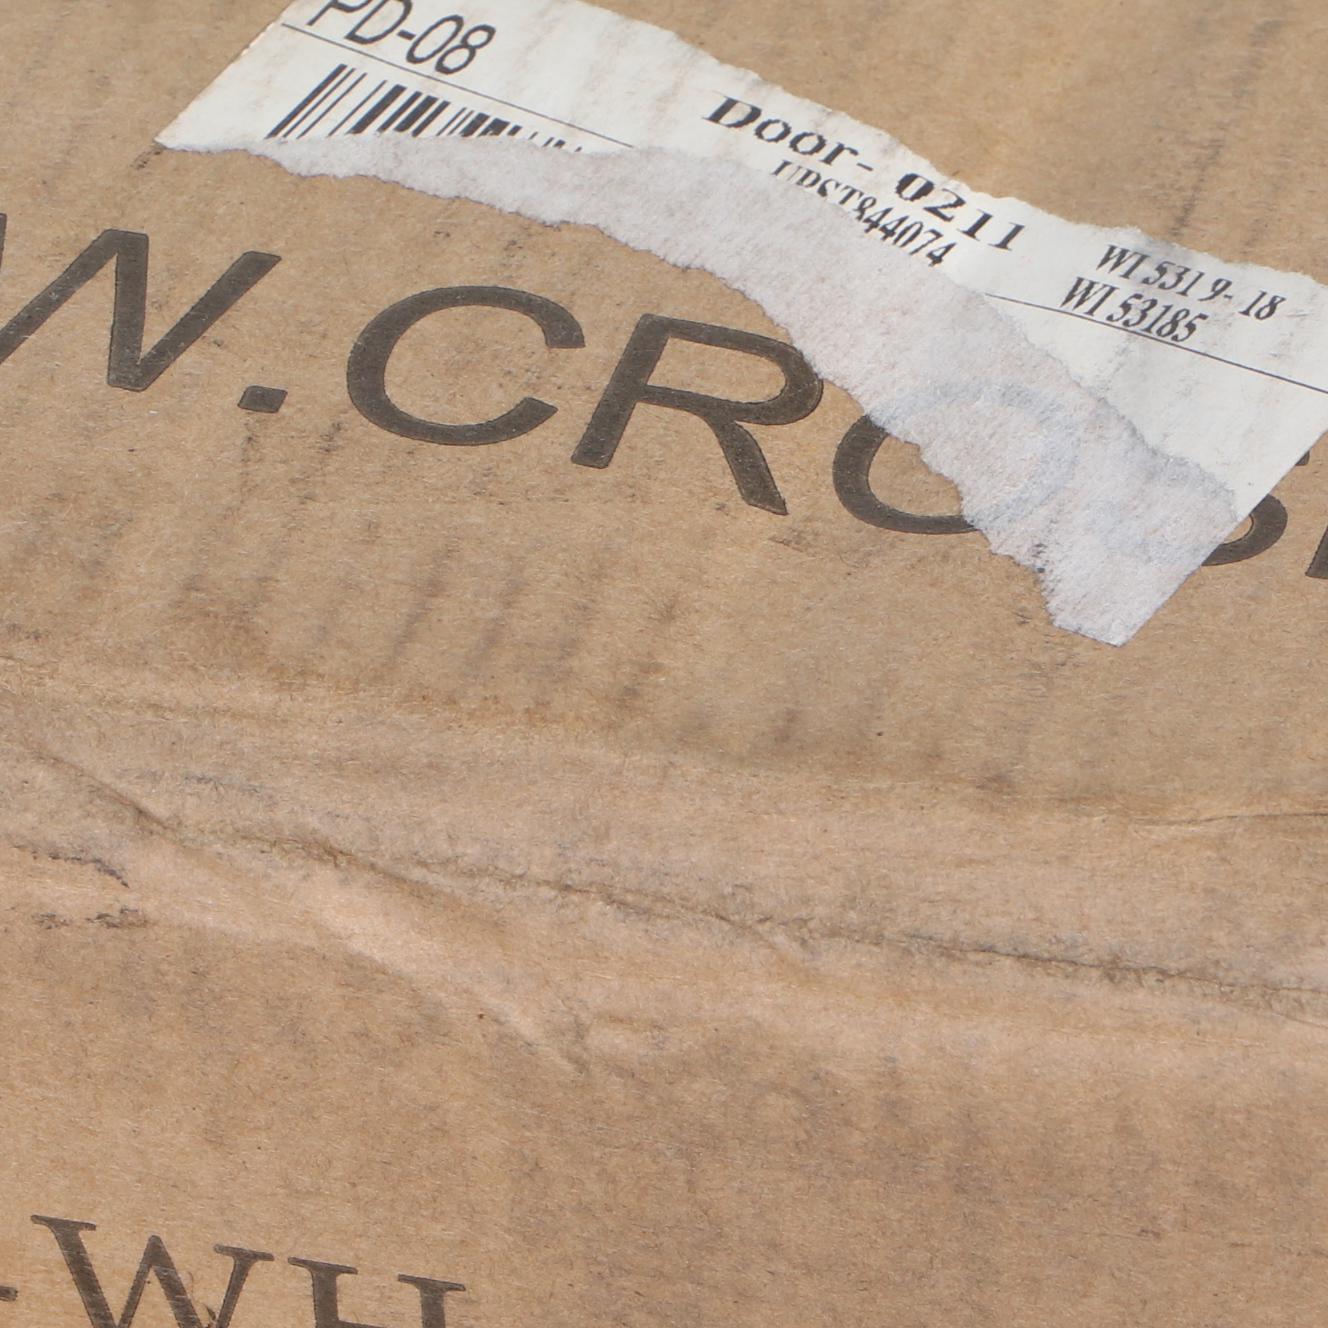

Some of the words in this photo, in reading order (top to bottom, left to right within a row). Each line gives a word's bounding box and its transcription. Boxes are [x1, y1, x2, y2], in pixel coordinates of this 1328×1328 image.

[703, 96, 874, 170] Door-
[895, 173, 1025, 251] 0211
[1096, 244, 1150, 280] WI
[1060, 276, 1119, 316] WI
[1107, 293, 1209, 342] 53185
